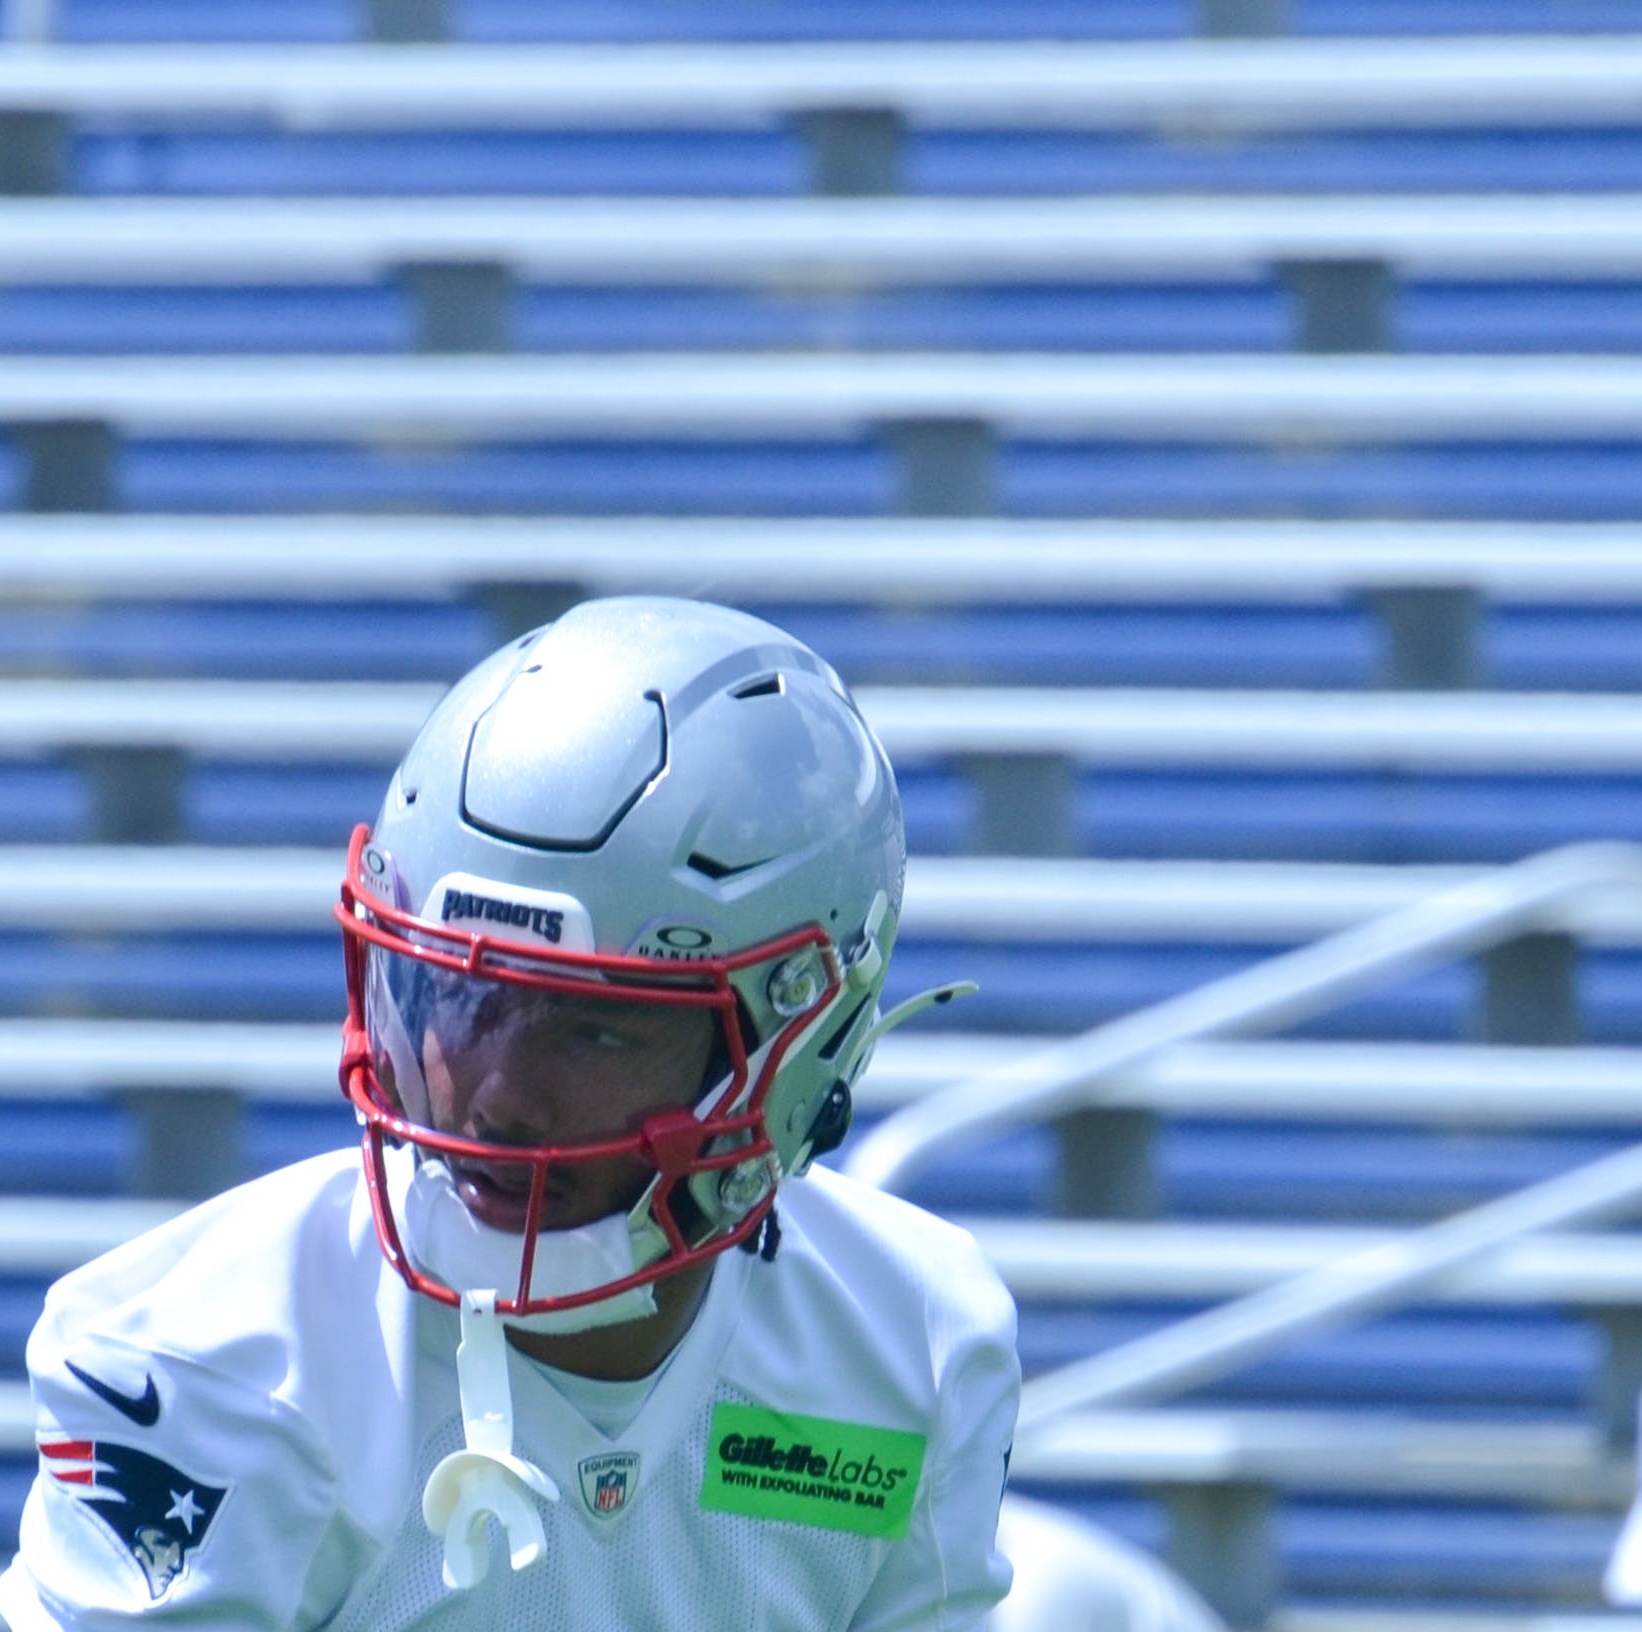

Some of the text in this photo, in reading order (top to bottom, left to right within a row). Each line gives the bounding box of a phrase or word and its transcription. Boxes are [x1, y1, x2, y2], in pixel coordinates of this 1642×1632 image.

[441, 888, 564, 944] PATRIOTS
[598, 1487, 626, 1508] NFL
[721, 1469, 885, 1510] WITH EXFOLIATING BAR
